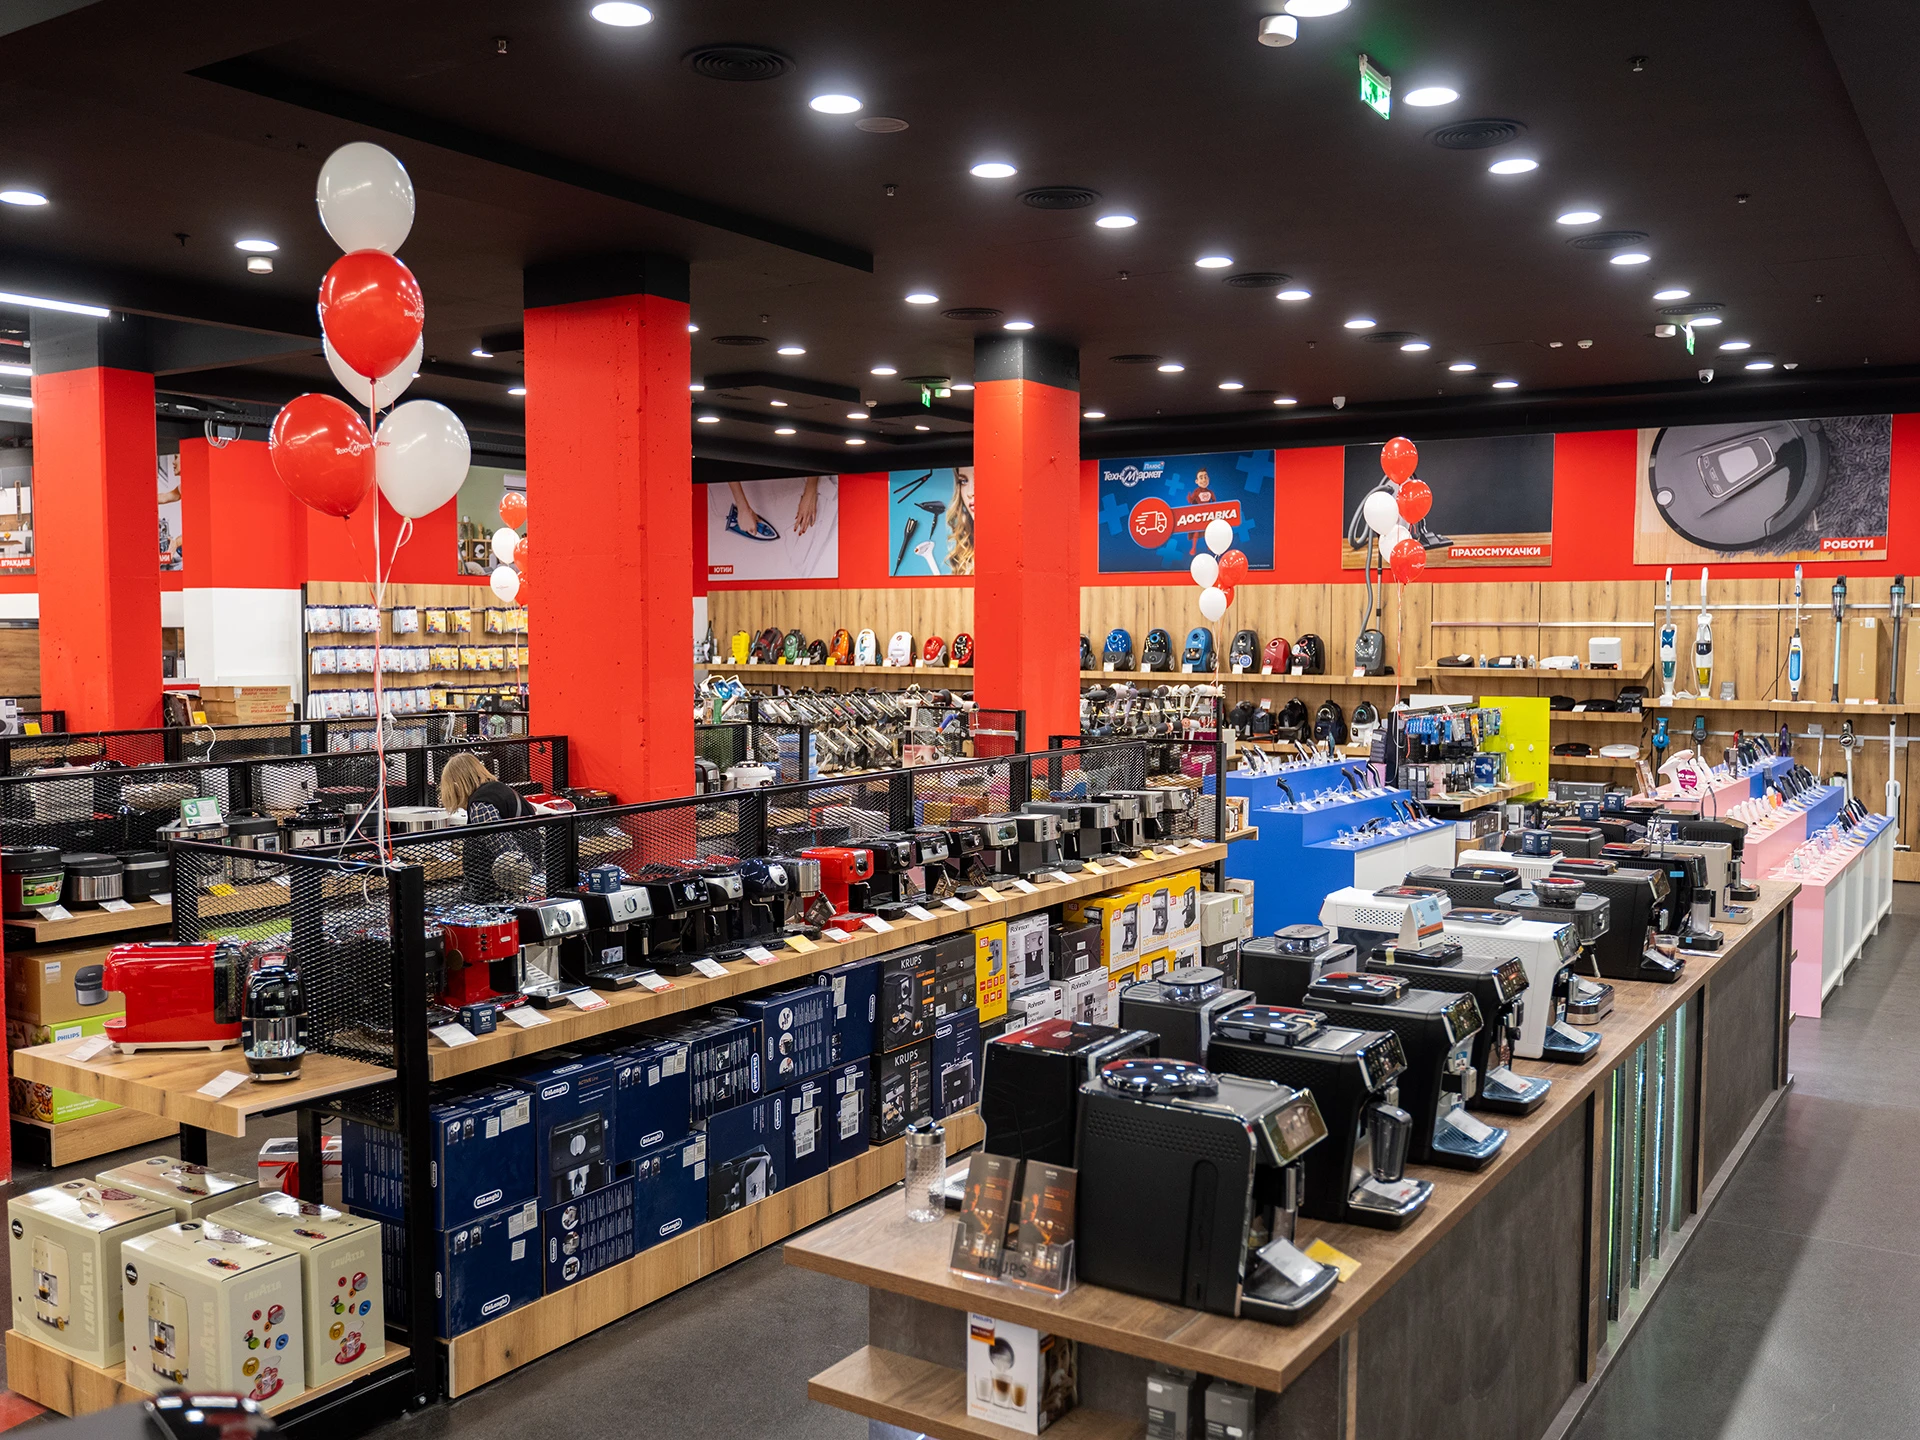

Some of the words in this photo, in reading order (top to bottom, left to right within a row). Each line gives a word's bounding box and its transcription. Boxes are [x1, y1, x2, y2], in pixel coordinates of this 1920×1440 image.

[1176, 509, 1237, 526] ДОСТАВКА
[1824, 540, 1874, 549] РОБОТИ
[1451, 547, 1541, 557] ПРАХОСМУКАЧКИ
[1010, 924, 1030, 933] Rohnson
[1170, 928, 1186, 939] COFFEE
[980, 938, 988, 948] NEO
[900, 954, 922, 969] KRUPS
[1071, 980, 1091, 990] Rohnson
[57, 1032, 80, 1041] PHILIPS
[894, 1049, 918, 1067] KRUPS
[331, 1250, 366, 1269] LAVAZZA
[978, 1257, 1027, 1278] KRUPS
